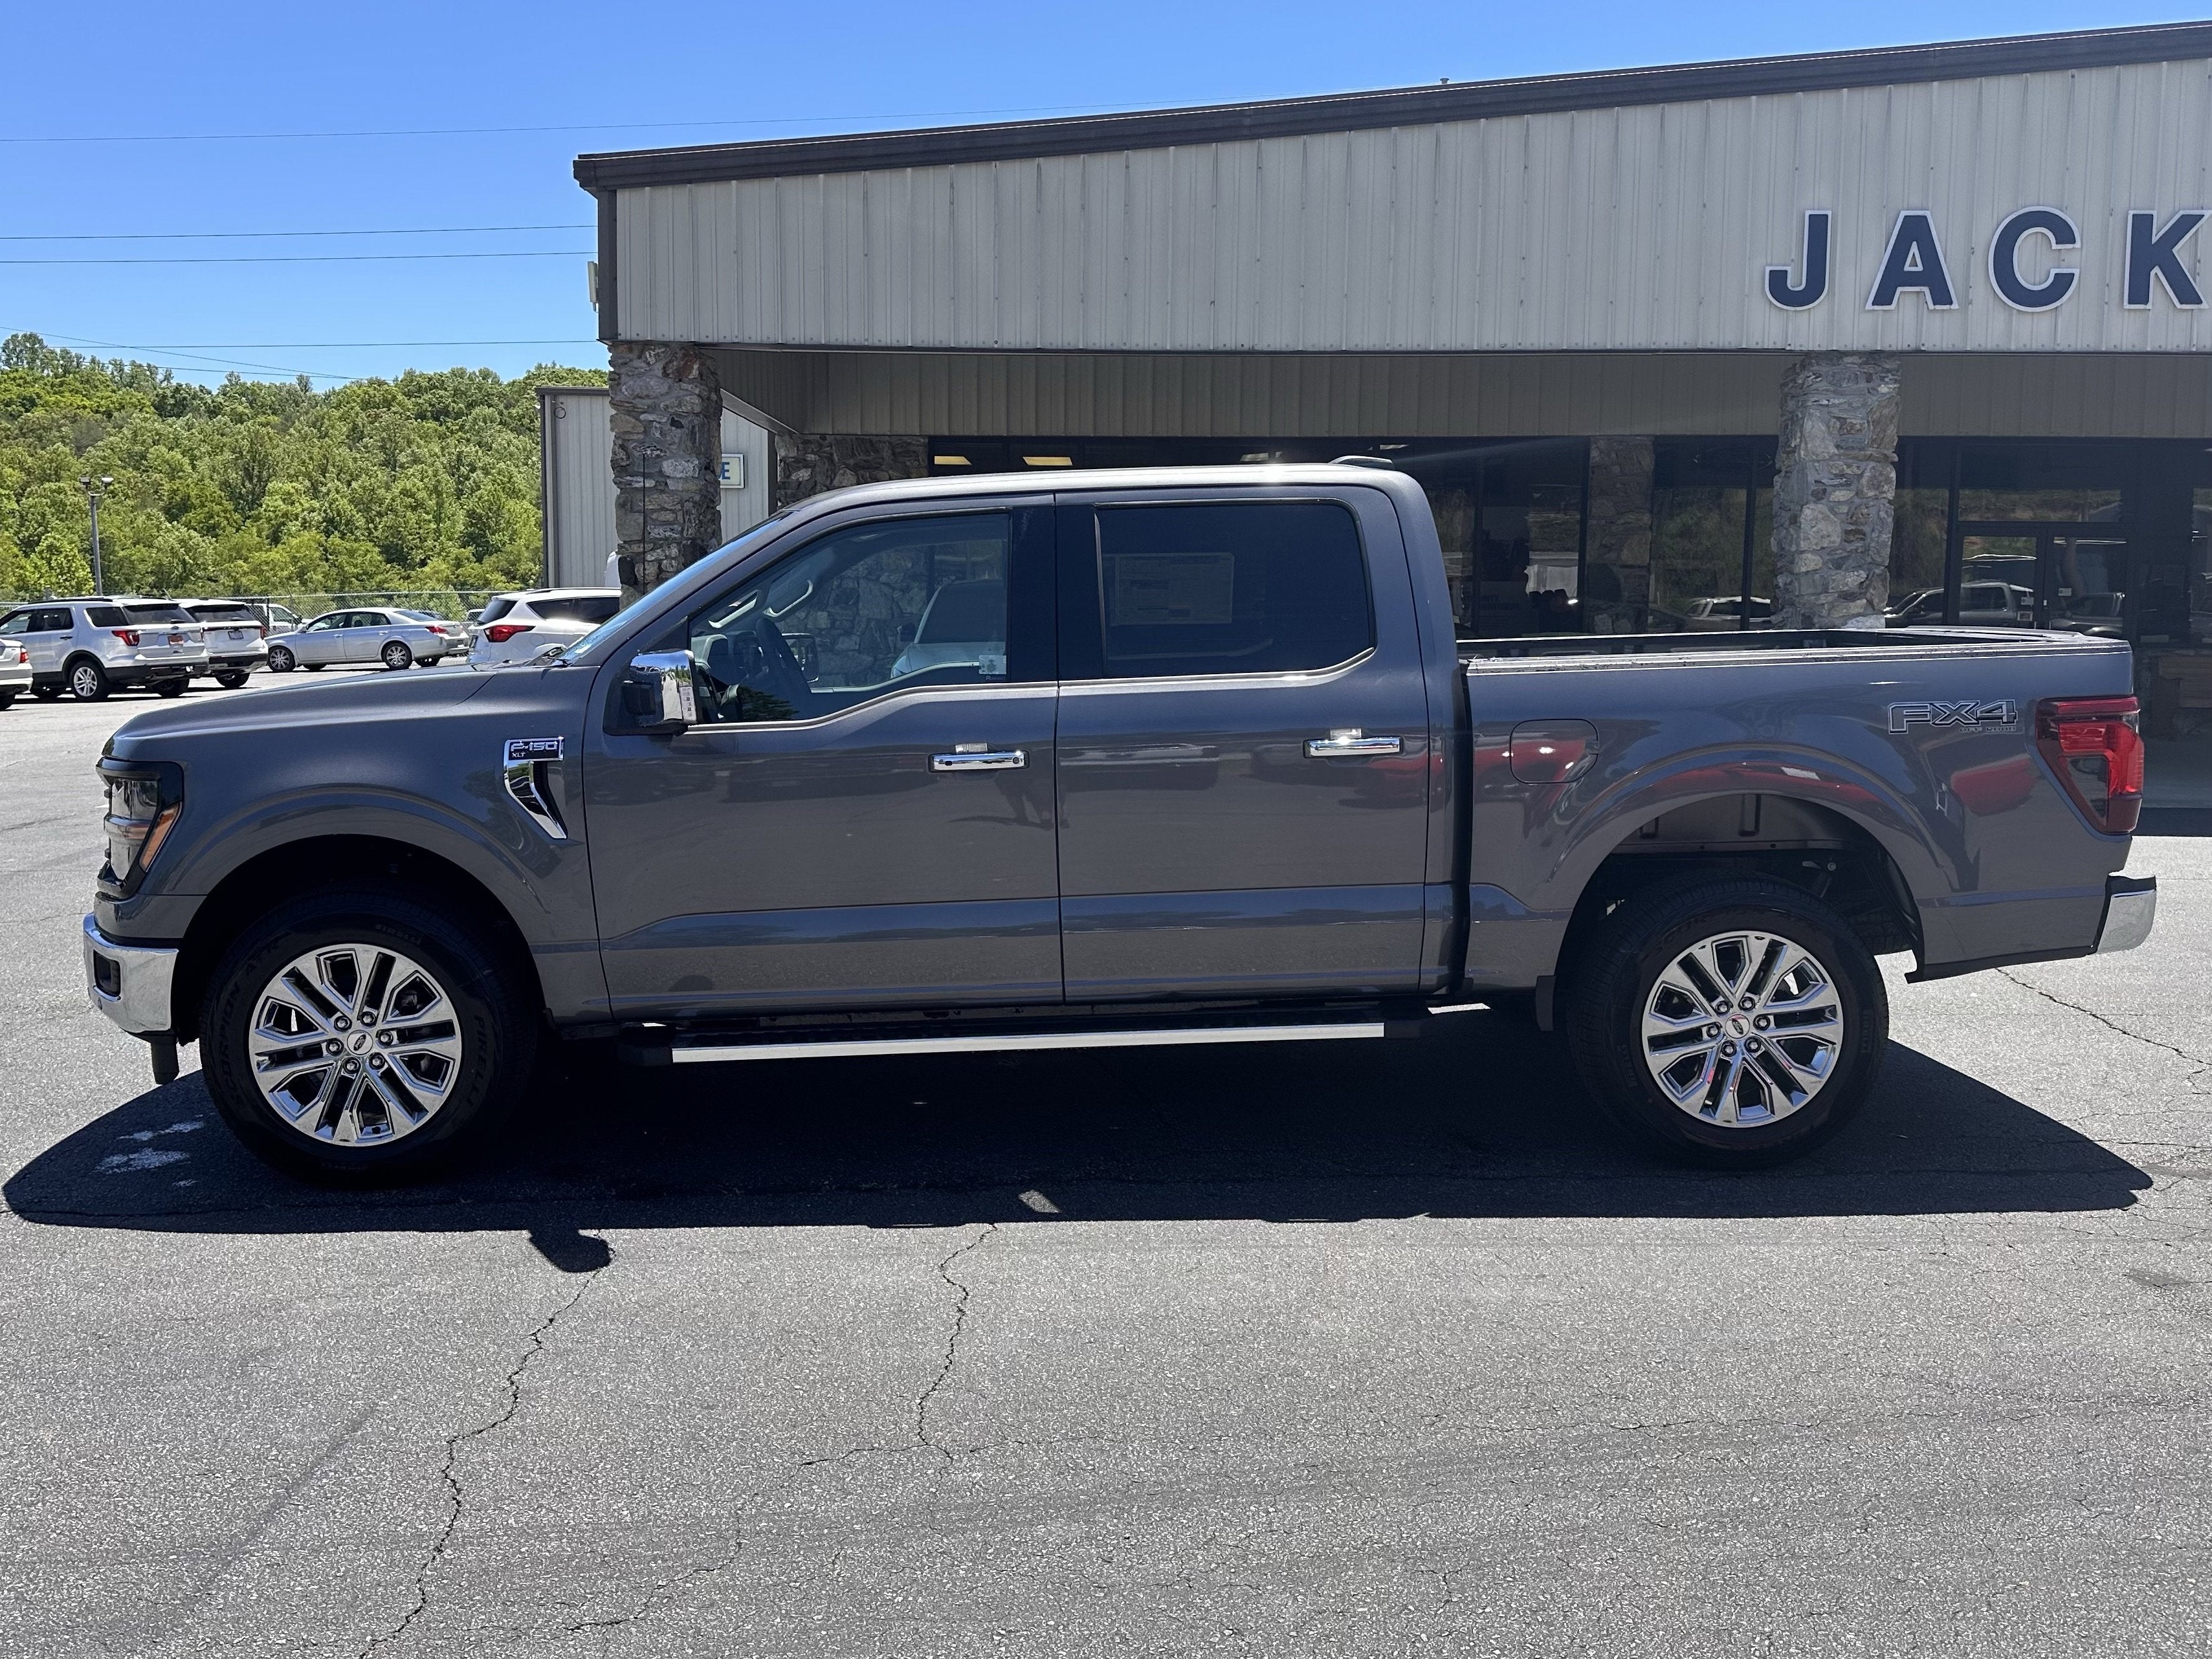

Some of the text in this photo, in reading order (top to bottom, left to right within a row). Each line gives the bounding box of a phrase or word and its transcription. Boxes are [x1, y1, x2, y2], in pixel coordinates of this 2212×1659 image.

[1765, 206, 2212, 313] JACK
[1888, 699, 2018, 734] FX4
[511, 741, 558, 751] F-150
